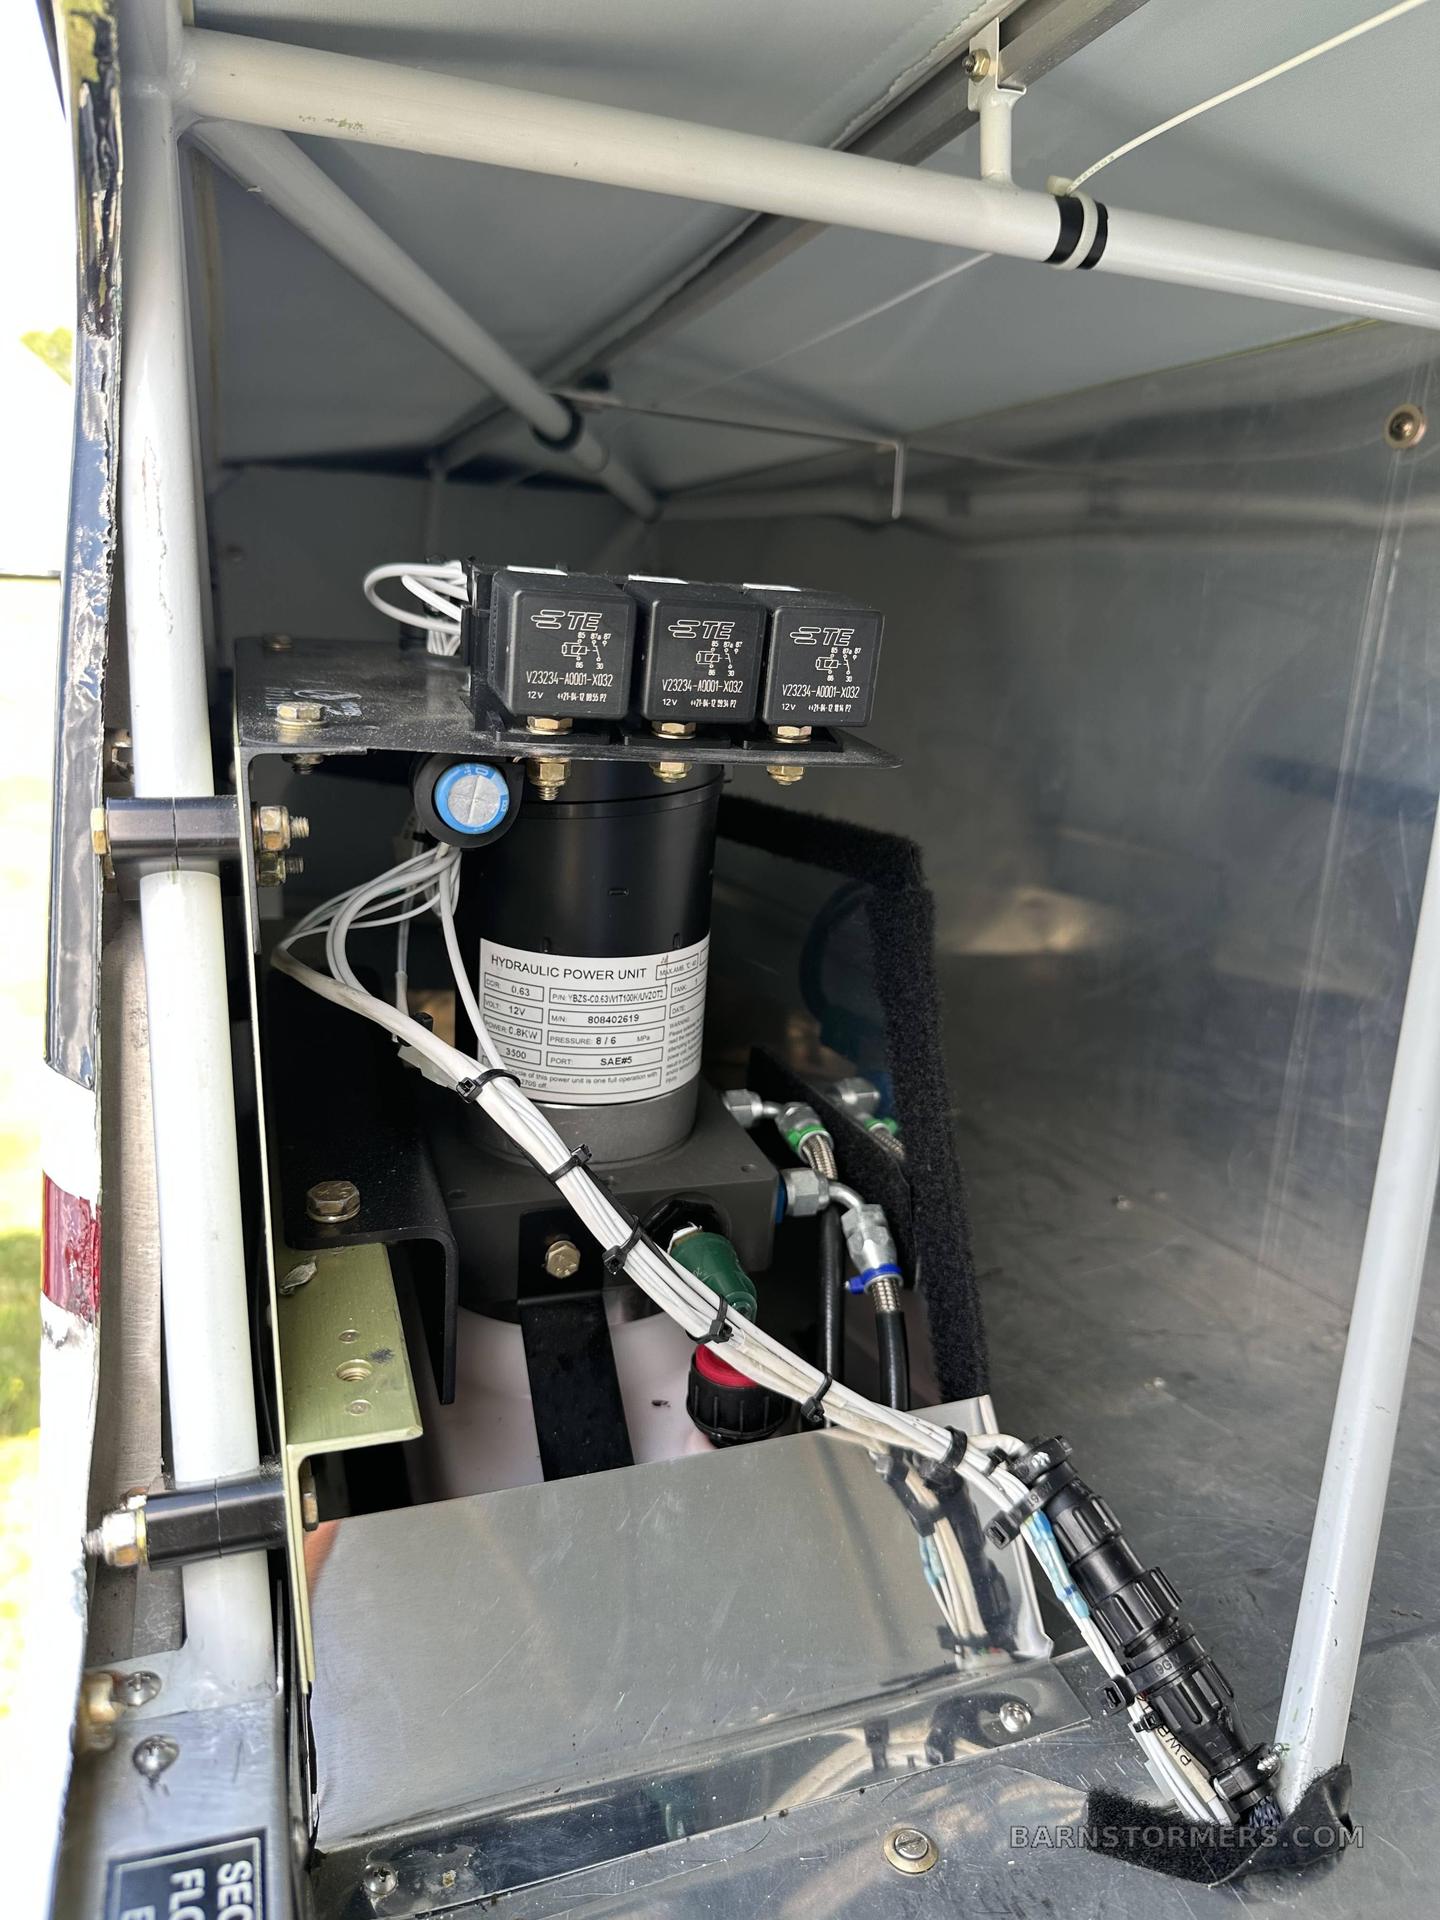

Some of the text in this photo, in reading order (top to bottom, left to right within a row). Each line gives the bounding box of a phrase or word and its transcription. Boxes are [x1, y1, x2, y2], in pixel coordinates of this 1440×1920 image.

[567, 611, 602, 631] TE
[702, 621, 735, 640] TE
[823, 628, 855, 646] TE
[526, 670, 614, 687] V23234-A0001-X032
[662, 679, 744, 693] V23234-A0001-X032
[782, 684, 860, 698] V23234-A0001-X032
[491, 954, 647, 980] HYDRAULIC POWER UNIT
[511, 985, 530, 997] 0.63
[509, 1006, 526, 1016] 12V
[587, 1014, 640, 1024] 808402619
[508, 1026, 538, 1040] 0.8KW
[550, 1036, 593, 1045] PRESSURE:
[596, 1037, 602, 1045] 8
[610, 1036, 617, 1045] 6
[505, 1047, 527, 1060] 3500
[600, 1056, 633, 1066] SAE#5
[550, 1076, 570, 1084] power
[618, 1073, 646, 1083] operation
